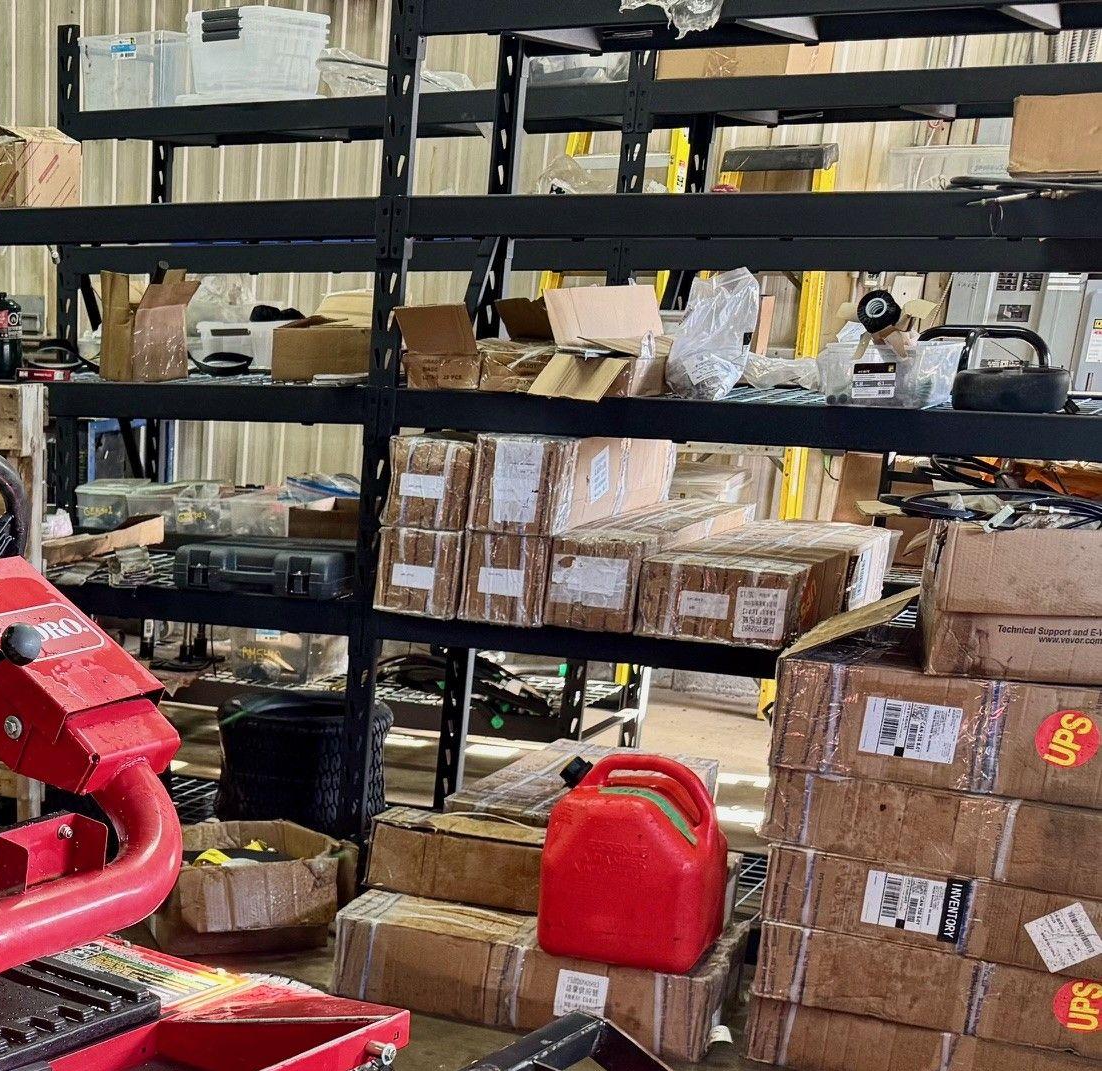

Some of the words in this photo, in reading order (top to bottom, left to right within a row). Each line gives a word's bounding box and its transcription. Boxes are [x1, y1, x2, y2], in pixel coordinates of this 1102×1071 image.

[34, 617, 83, 642] RO
[998, 624, 1036, 635] Technical
[1038, 626, 1071, 639] Support
[1073, 628, 1088, 636] and
[1090, 628, 1102, 637] E-
[1042, 713, 1093, 766] UPS
[943, 883, 964, 939] INVENTORY
[1066, 982, 1102, 1031] UPS
